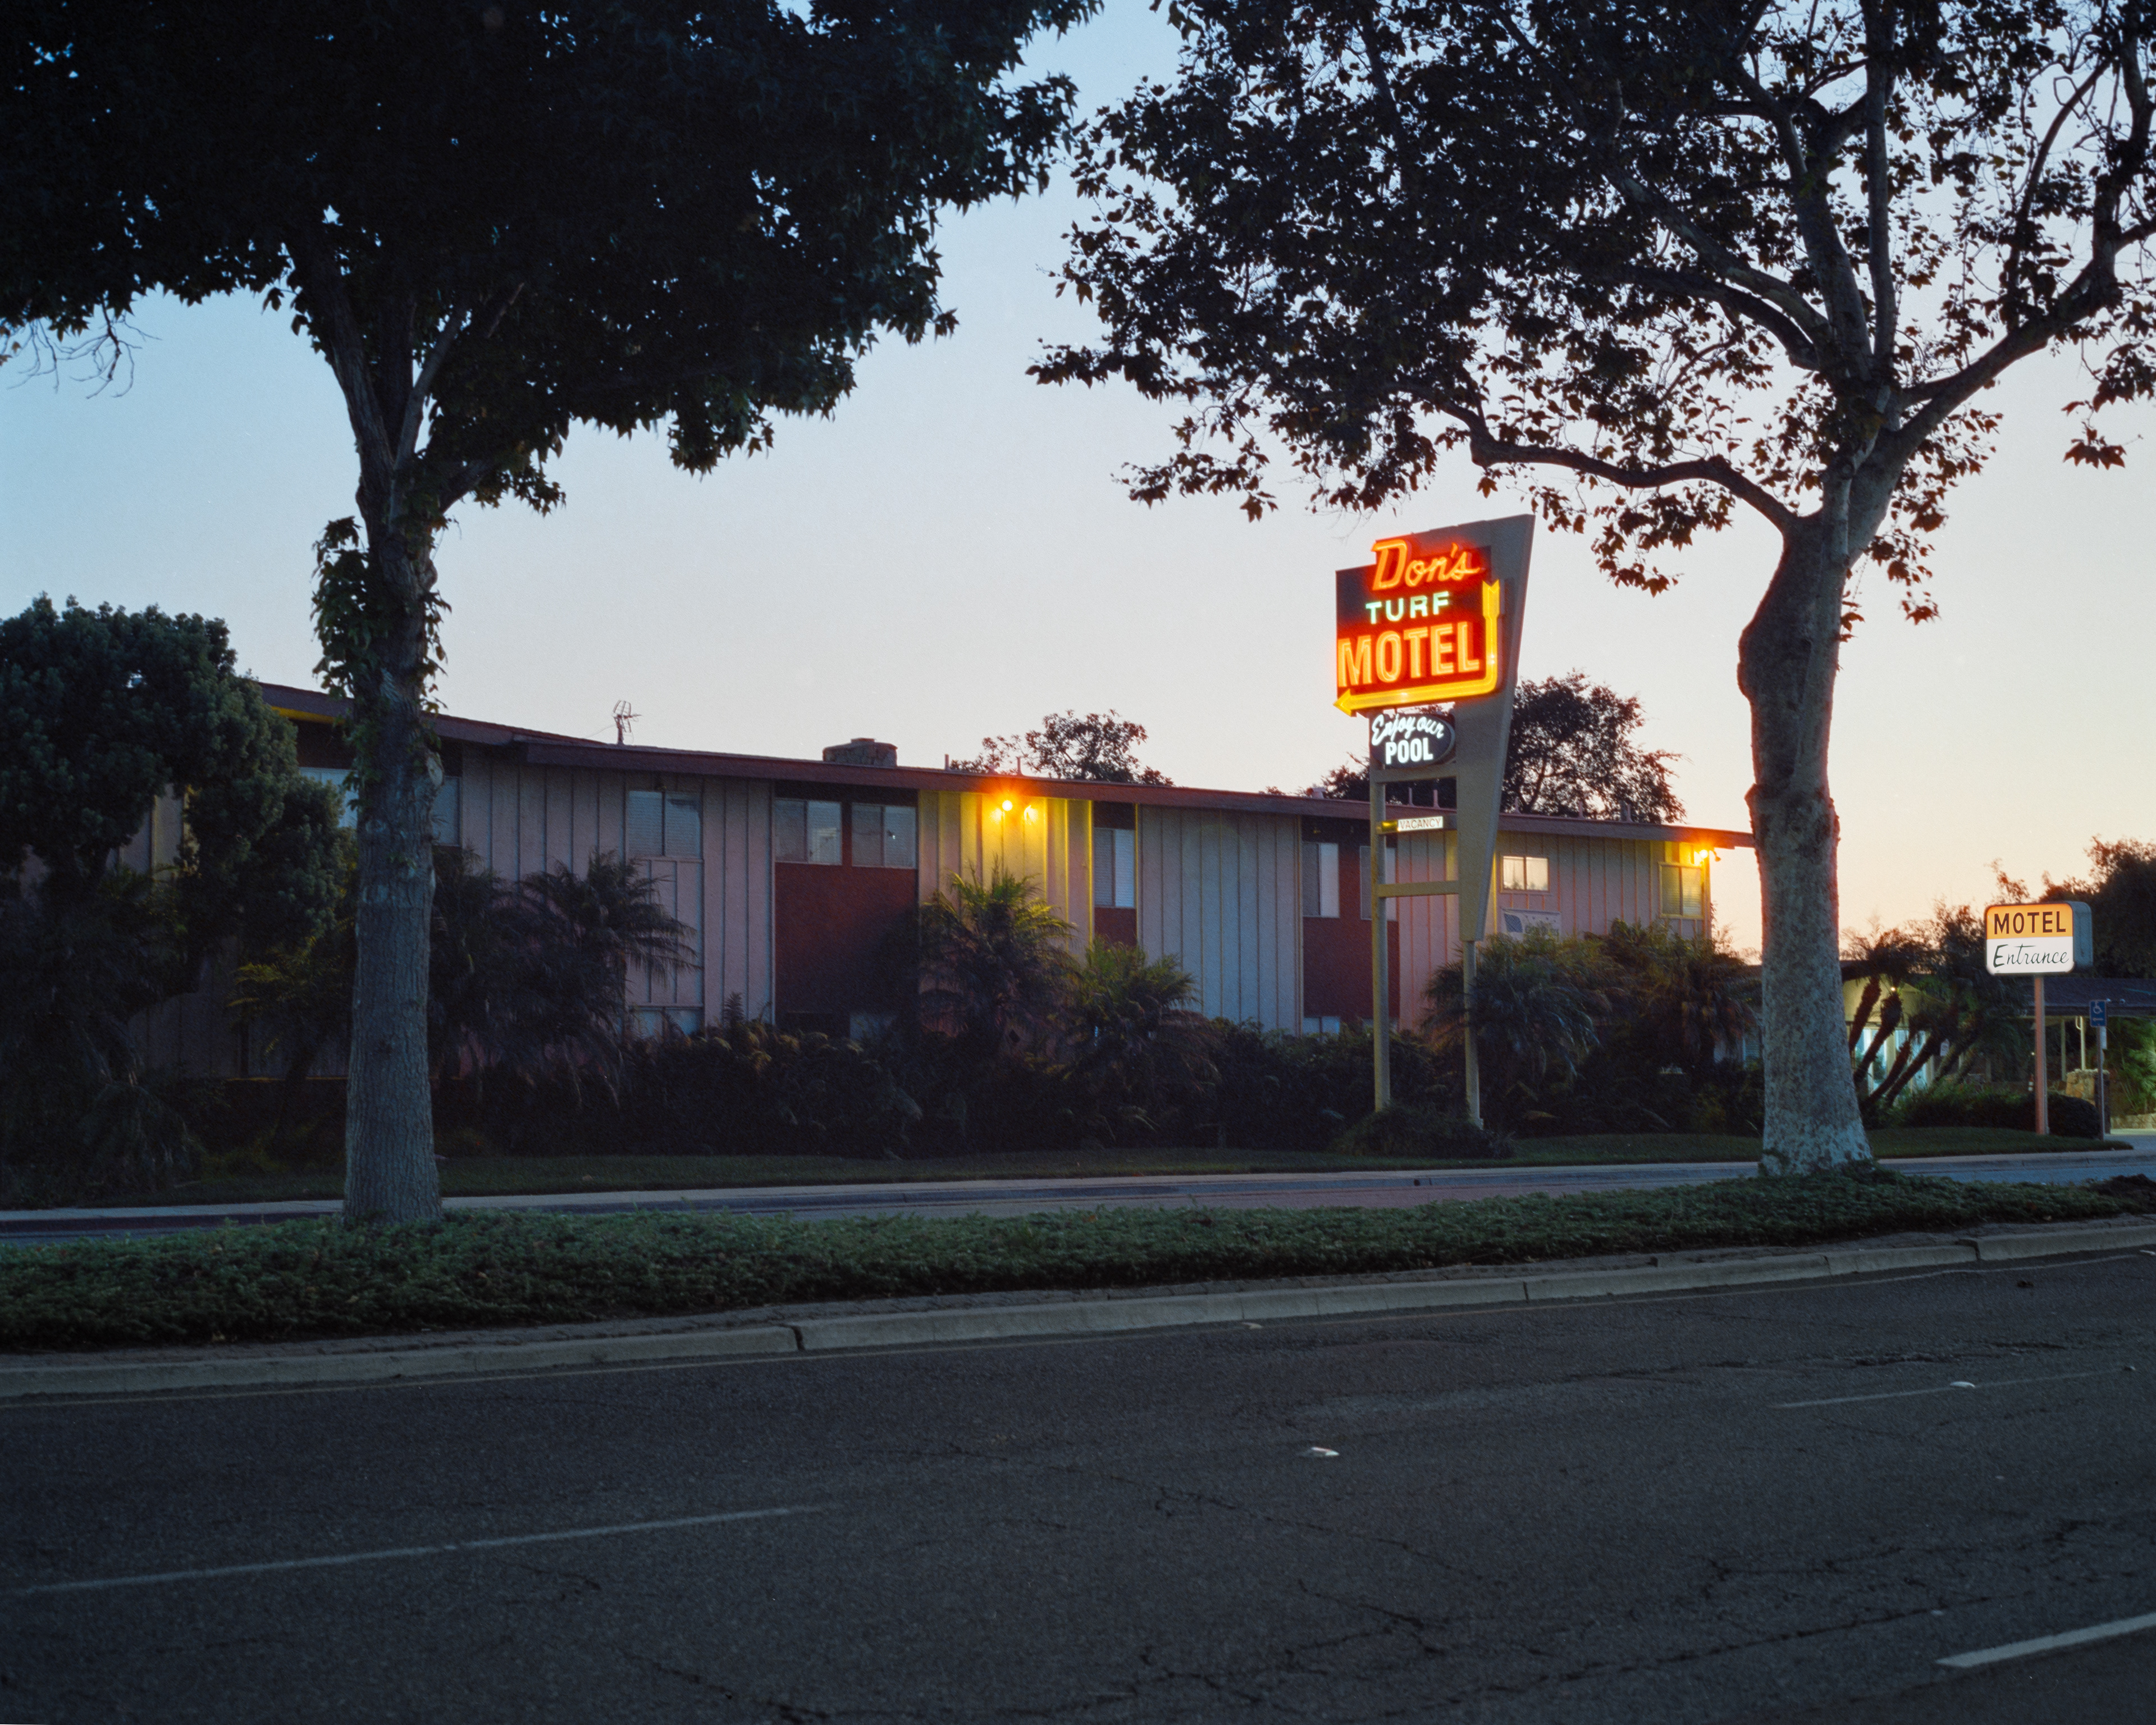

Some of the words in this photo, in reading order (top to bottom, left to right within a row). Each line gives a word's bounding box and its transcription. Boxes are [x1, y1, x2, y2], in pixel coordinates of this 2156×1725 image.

[1371, 539, 1481, 590] Don's
[1365, 591, 1449, 624] TURF
[1337, 621, 1480, 687] MOTEL
[1372, 714, 1415, 746] Enjoy
[1417, 717, 1444, 739] our
[1385, 737, 1433, 764] POOL
[1400, 818, 1441, 829] VACANCY
[1994, 911, 2066, 934] MOTEL
[1993, 943, 2069, 968] Entrance
